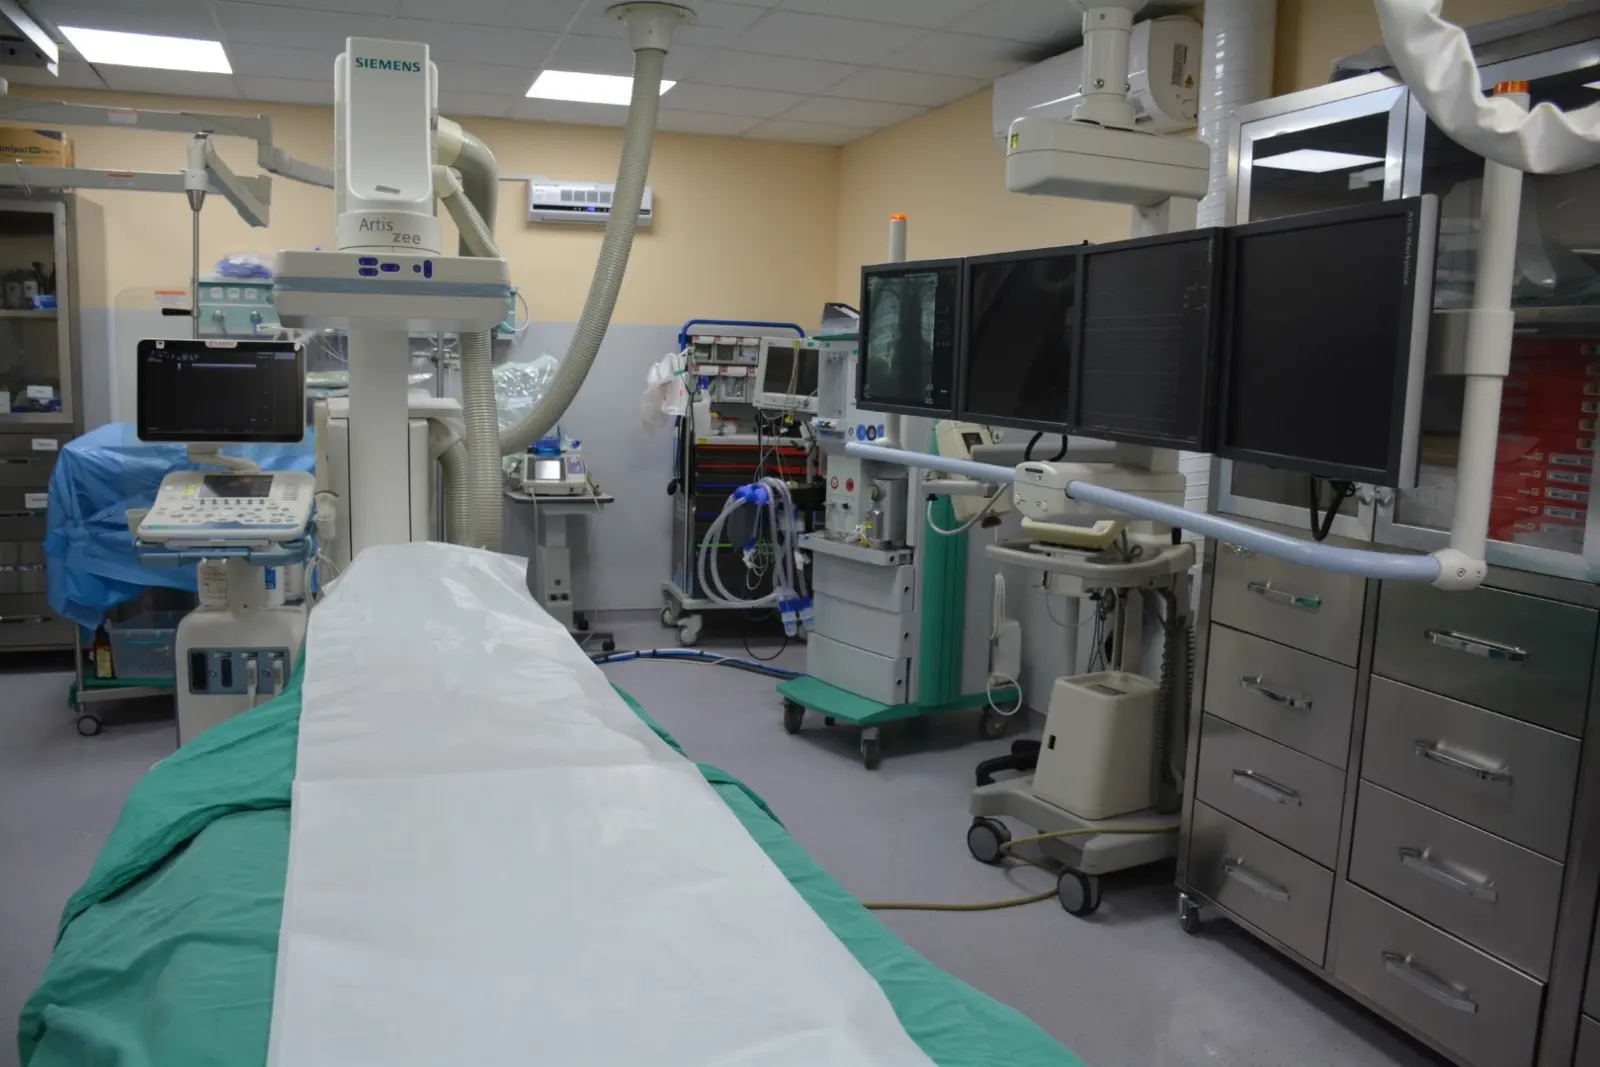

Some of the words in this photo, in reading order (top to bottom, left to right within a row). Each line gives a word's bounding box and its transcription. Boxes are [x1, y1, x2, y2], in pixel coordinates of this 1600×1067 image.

[355, 57, 421, 73] SIEMENS
[358, 217, 394, 232] Artis
[392, 232, 421, 245] zee
